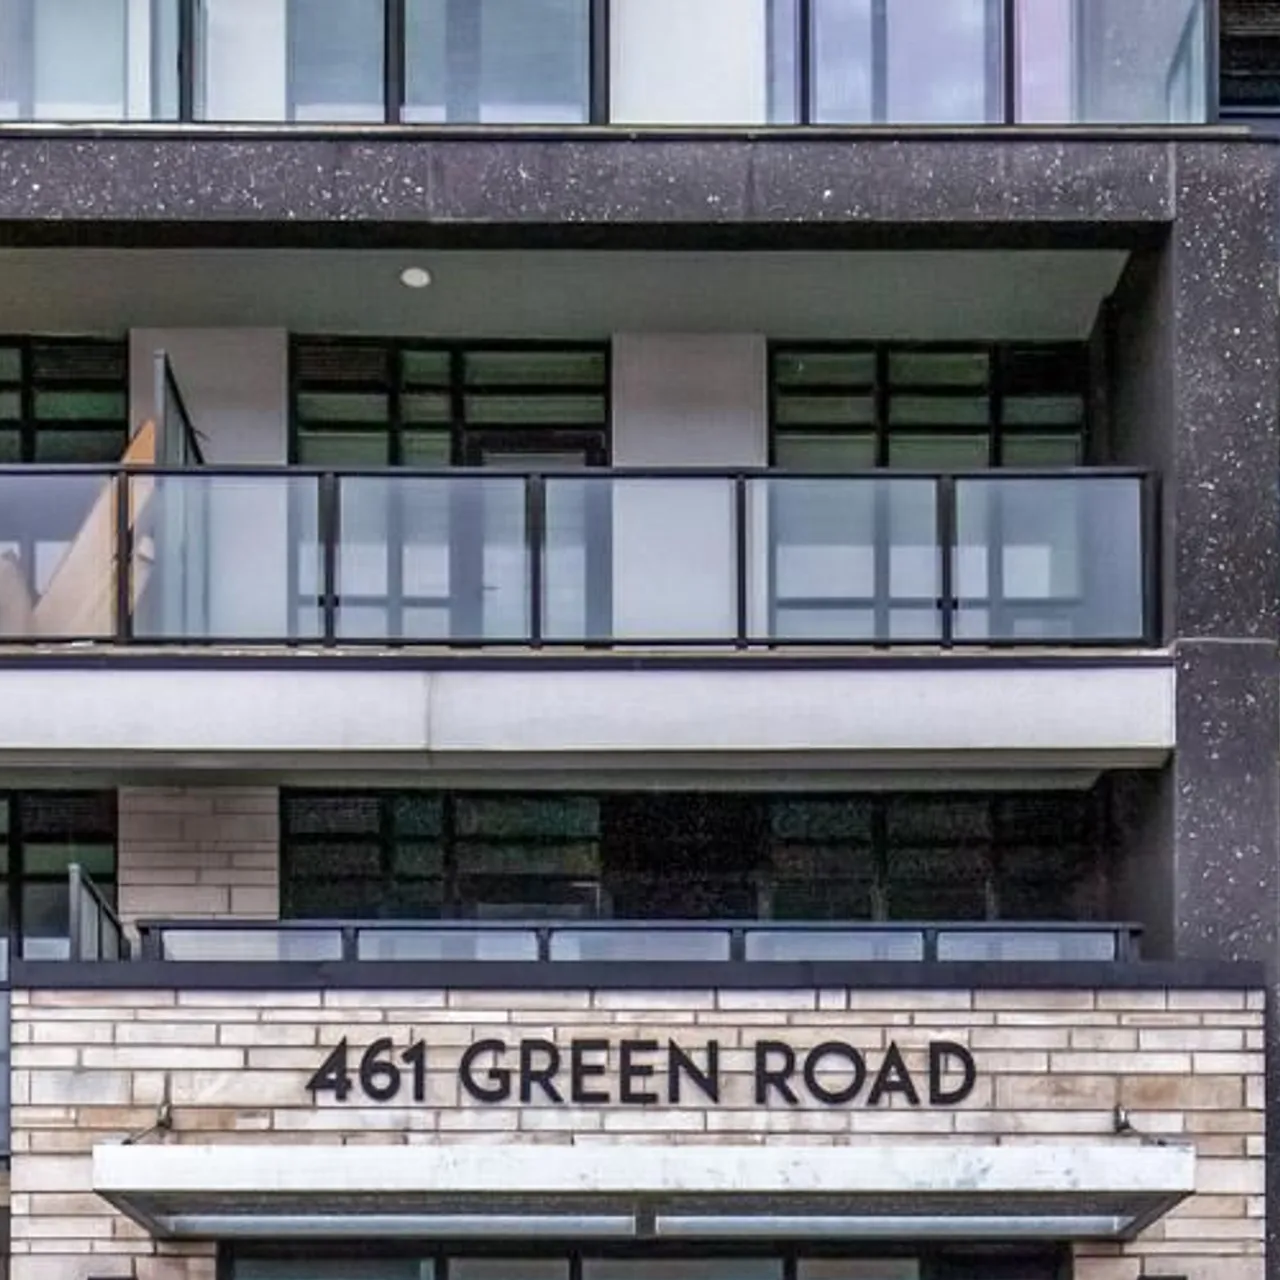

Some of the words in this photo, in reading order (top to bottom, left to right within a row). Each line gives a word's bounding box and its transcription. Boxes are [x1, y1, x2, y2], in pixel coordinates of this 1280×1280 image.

[306, 1037, 426, 1102] 461
[459, 1038, 720, 1104] GREEN
[755, 1040, 977, 1104] ROAD
